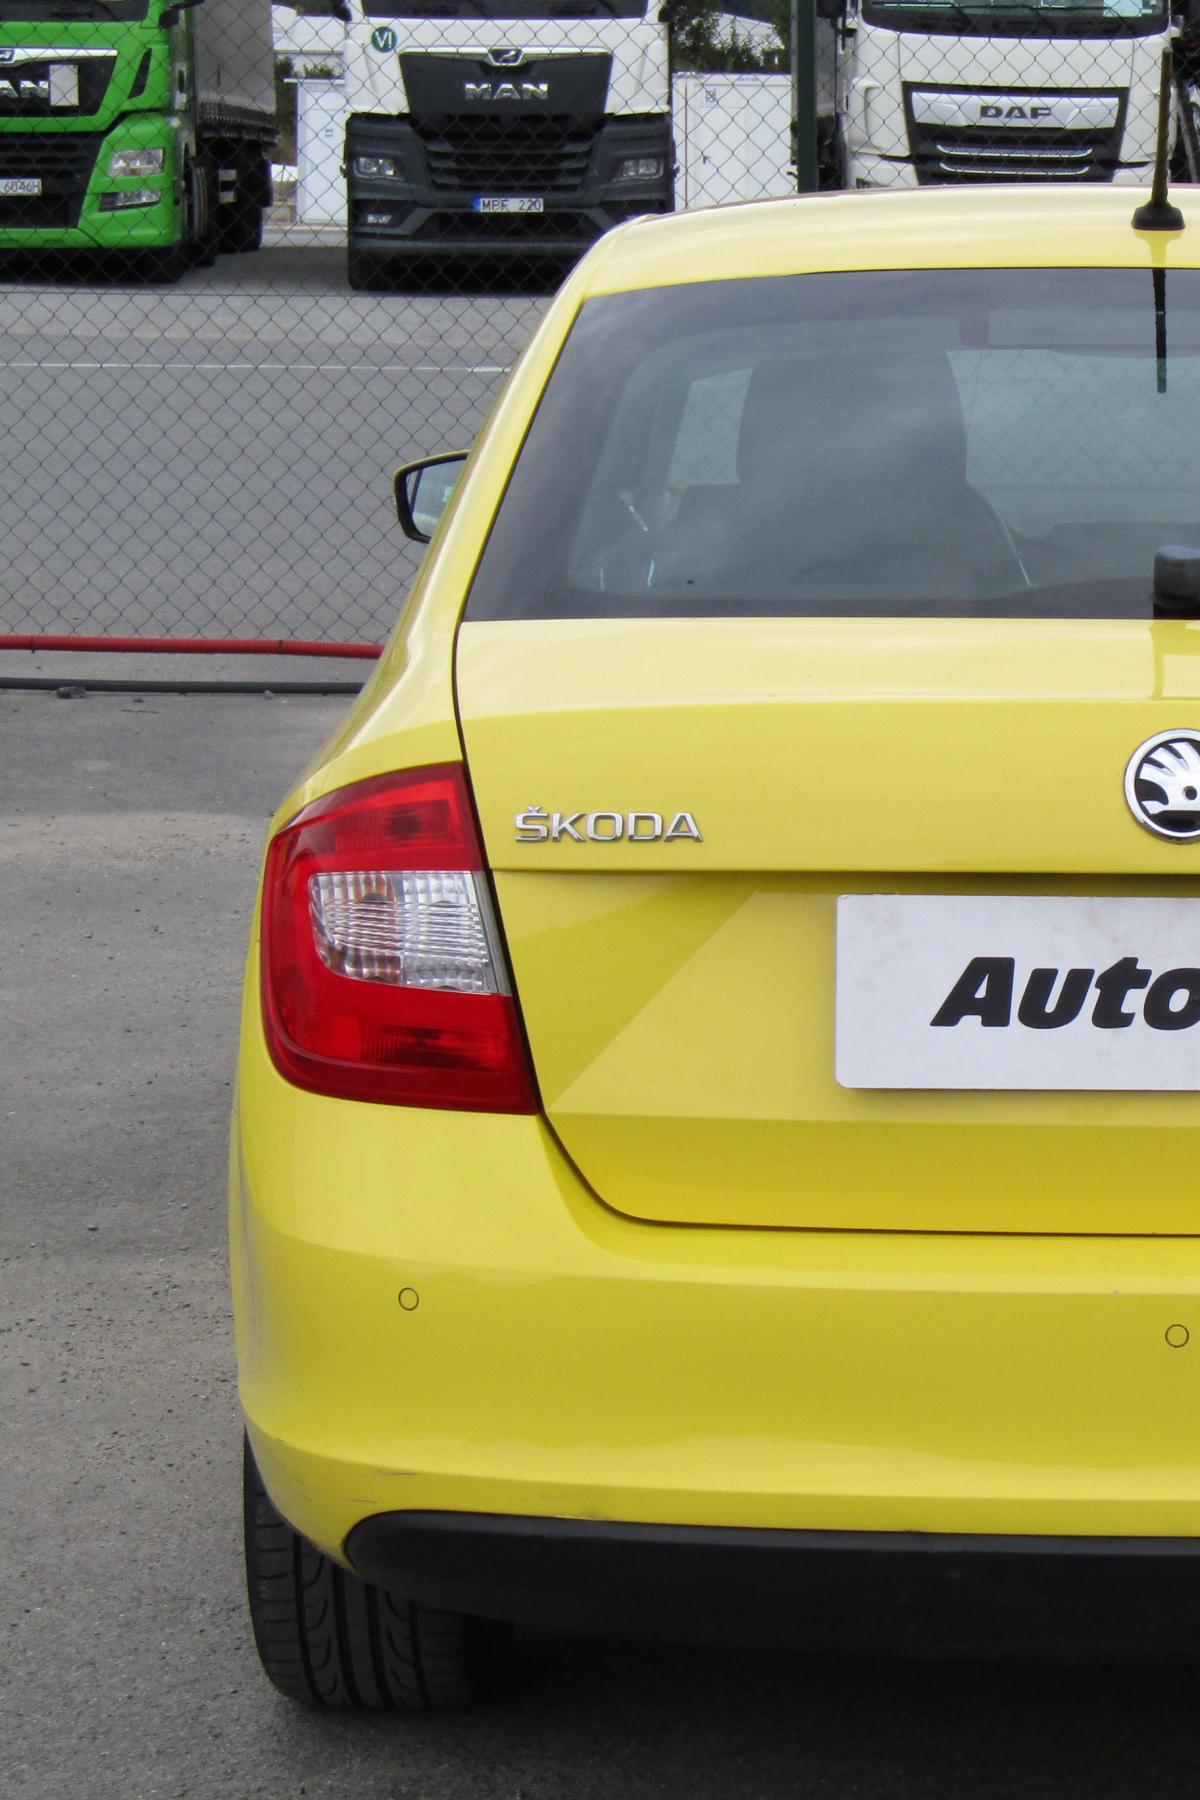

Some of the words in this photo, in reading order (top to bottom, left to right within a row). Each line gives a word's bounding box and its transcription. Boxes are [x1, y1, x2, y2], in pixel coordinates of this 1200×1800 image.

[0, 80, 49, 98] AN
[465, 83, 549, 100] MAN
[980, 105, 1051, 119] DAF
[514, 806, 704, 842] ŠKODA
